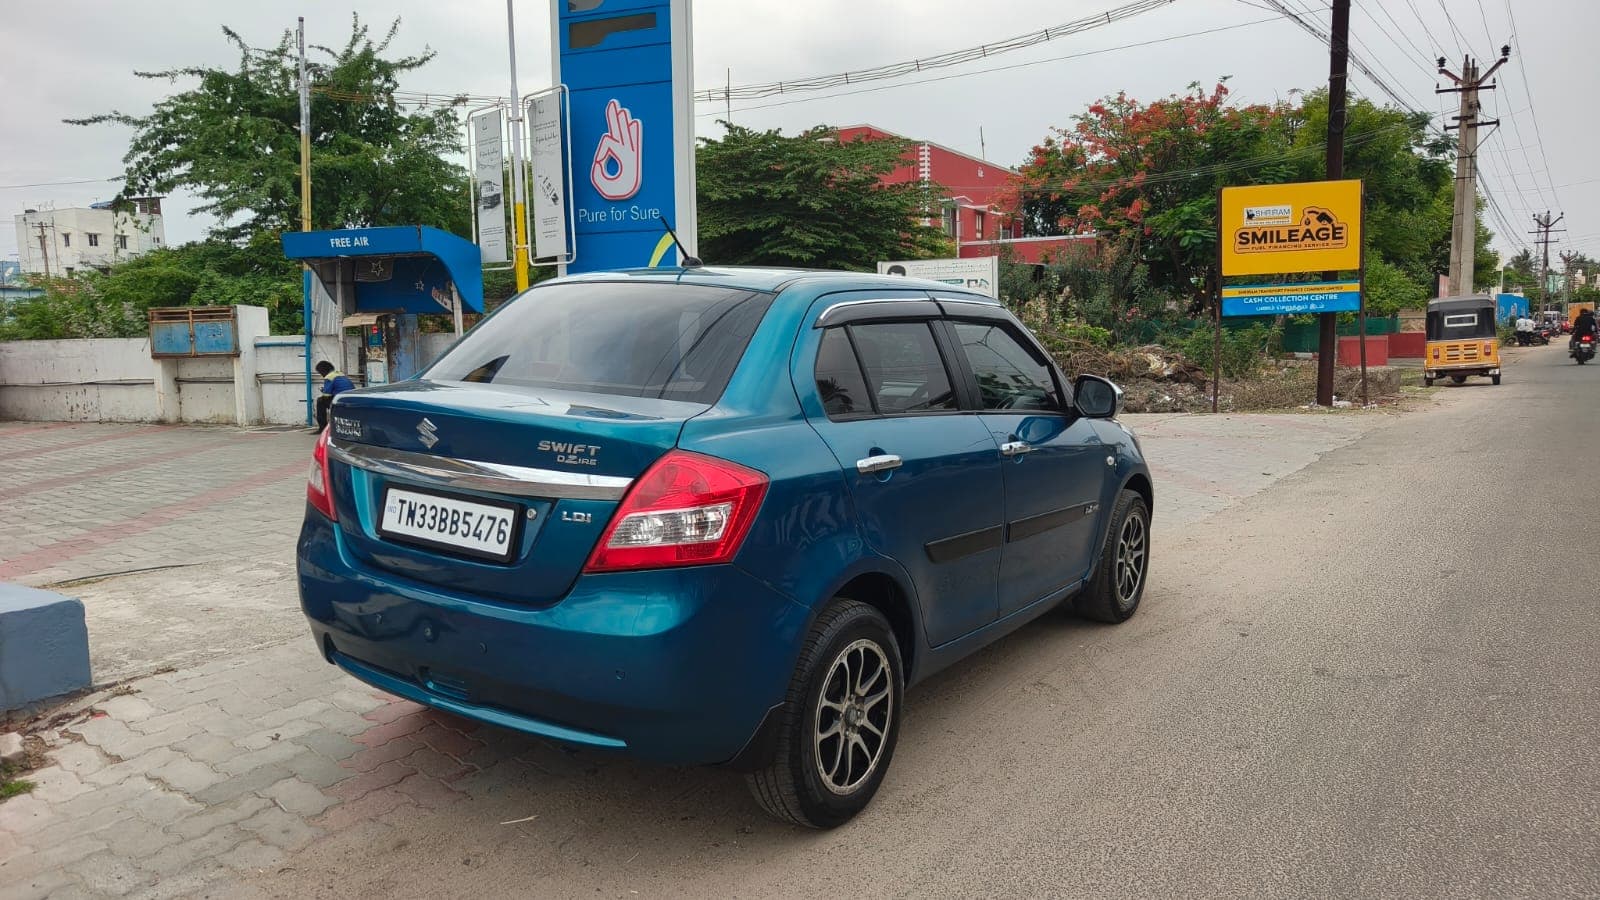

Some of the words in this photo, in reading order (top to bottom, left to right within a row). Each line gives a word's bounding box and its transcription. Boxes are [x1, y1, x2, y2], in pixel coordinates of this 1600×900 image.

[578, 208, 607, 223] Pure
[611, 206, 627, 221] for
[630, 205, 660, 221] Sure
[329, 237, 352, 248] FREE
[353, 236, 369, 247] AIR
[1238, 226, 1344, 245] SMILEAGE
[1243, 296, 1263, 304] CASH
[1264, 295, 1309, 303] COLLECTION
[1310, 293, 1339, 301] CENTRE
[537, 440, 602, 456] SWIFT
[556, 454, 598, 466] DZIRE
[397, 498, 509, 545] TN33BB5476
[561, 510, 592, 523] LDI
